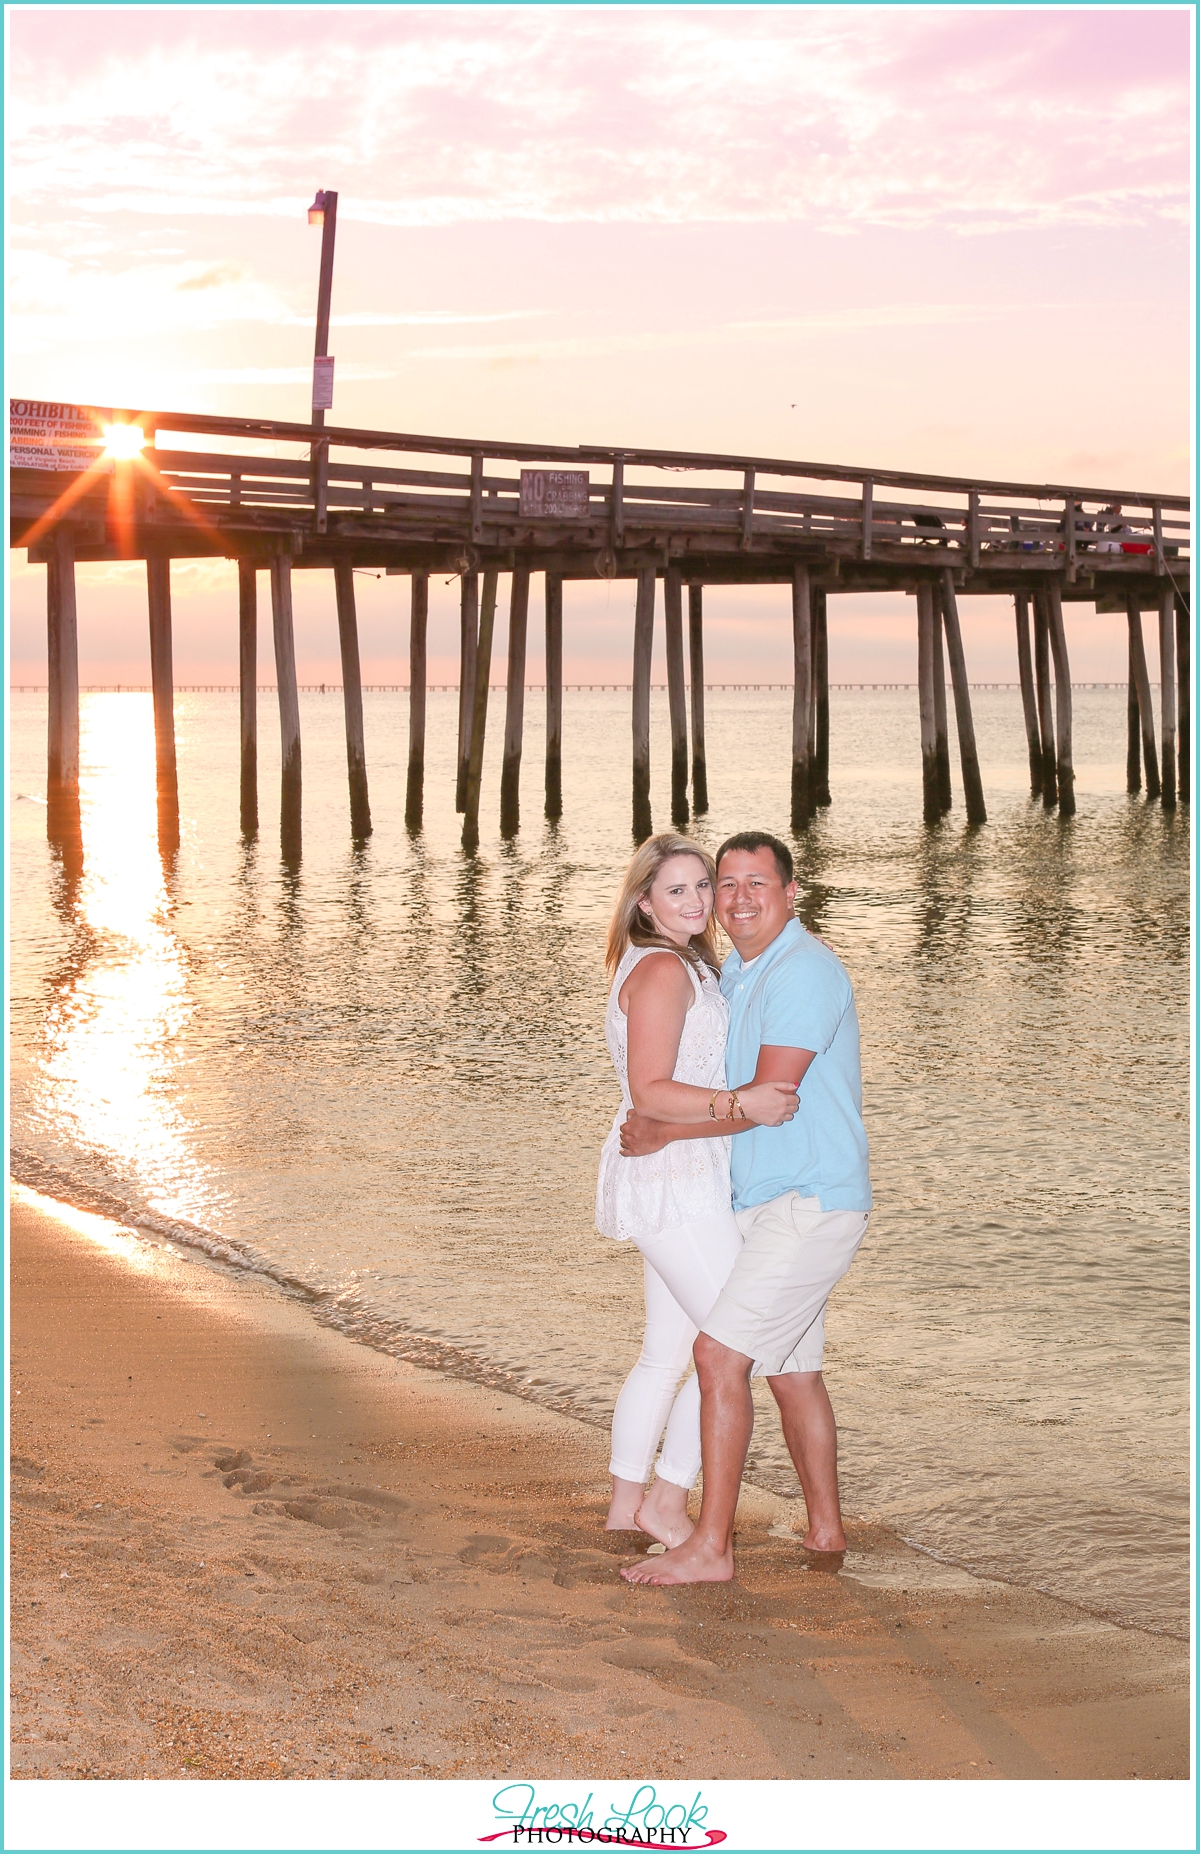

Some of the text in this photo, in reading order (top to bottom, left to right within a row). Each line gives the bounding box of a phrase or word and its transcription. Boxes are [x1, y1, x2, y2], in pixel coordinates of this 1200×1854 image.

[24, 419, 45, 428] FEET
[47, 420, 58, 428] OF
[60, 421, 92, 431] FISHING
[54, 430, 87, 439] FISHING
[10, 445, 55, 456] PERSONAL
[17, 460, 49, 468] VIOLATION
[549, 473, 584, 485] FISHING
[522, 472, 544, 501] NO
[546, 490, 588, 502] CRABBING
